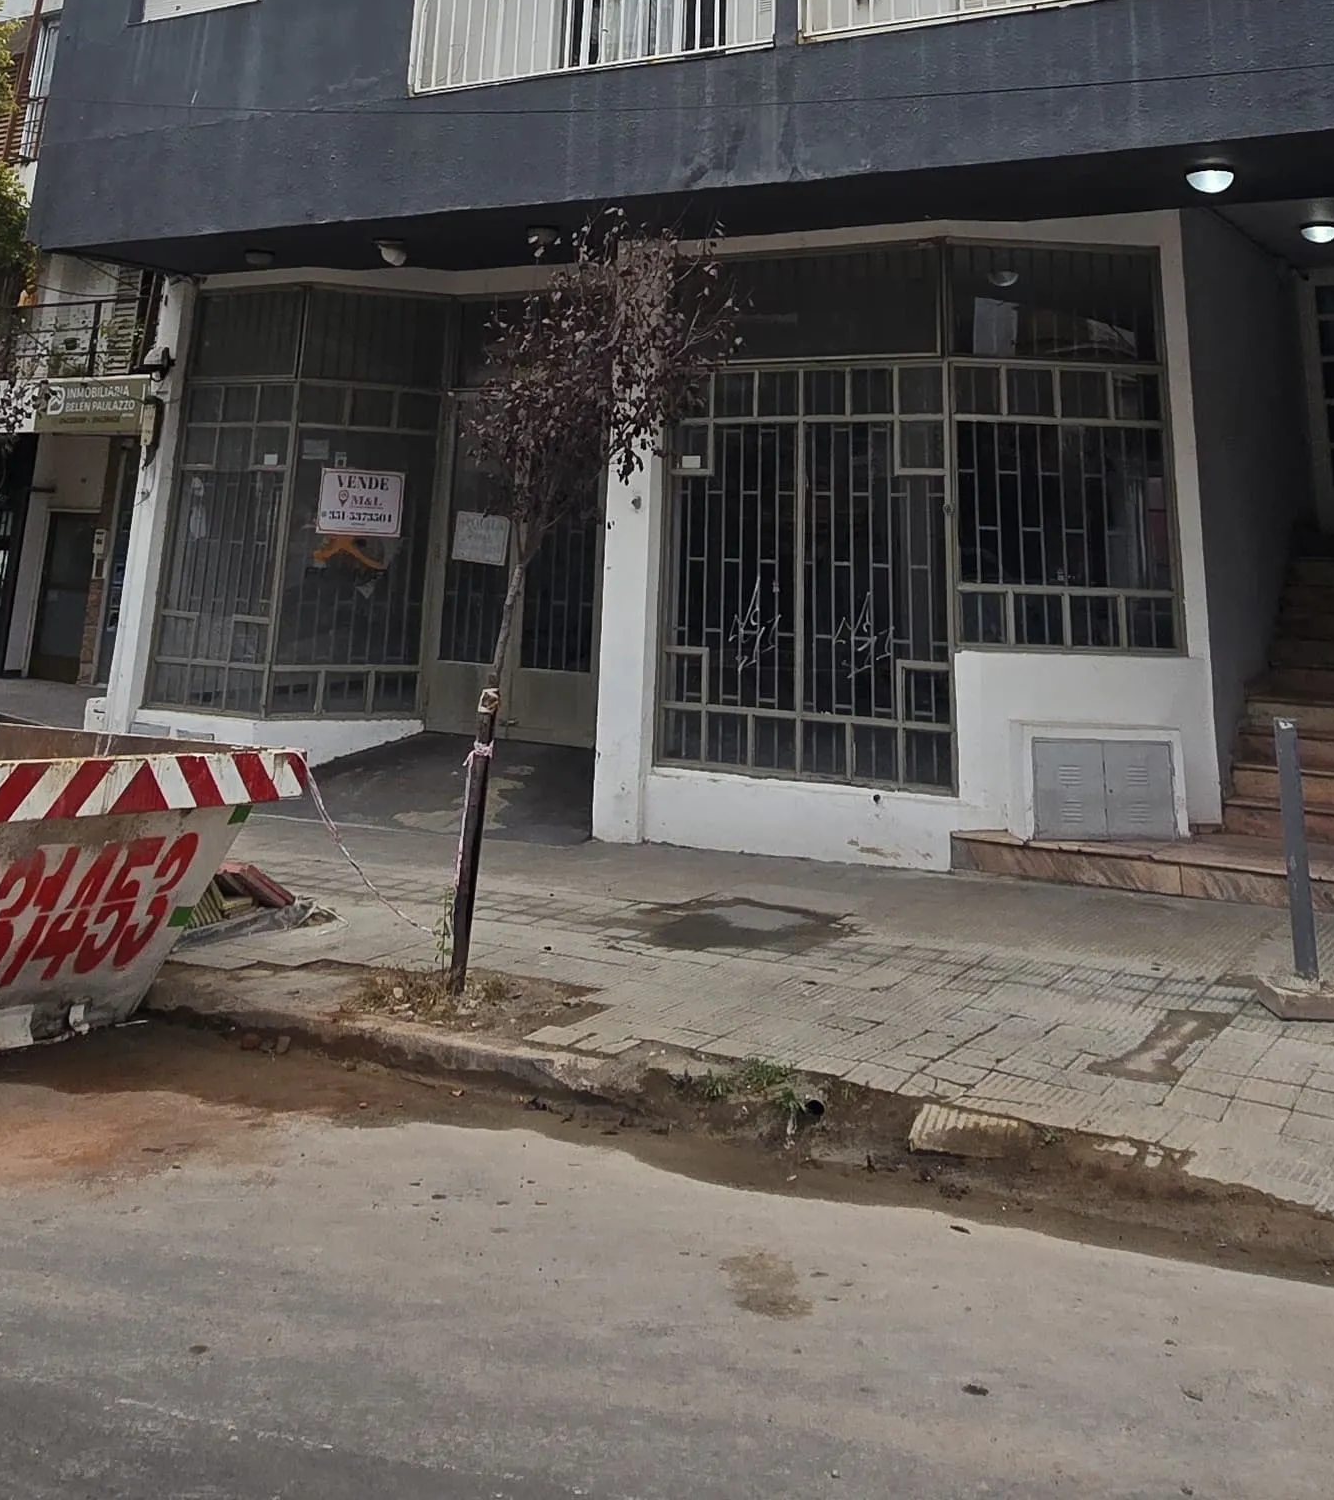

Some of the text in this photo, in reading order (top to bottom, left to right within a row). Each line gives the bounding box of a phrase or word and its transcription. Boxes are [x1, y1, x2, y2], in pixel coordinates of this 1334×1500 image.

[67, 385, 130, 398] INMOBILIARIA
[91, 399, 136, 412] PAULAZZO
[337, 474, 389, 491] VENDE
